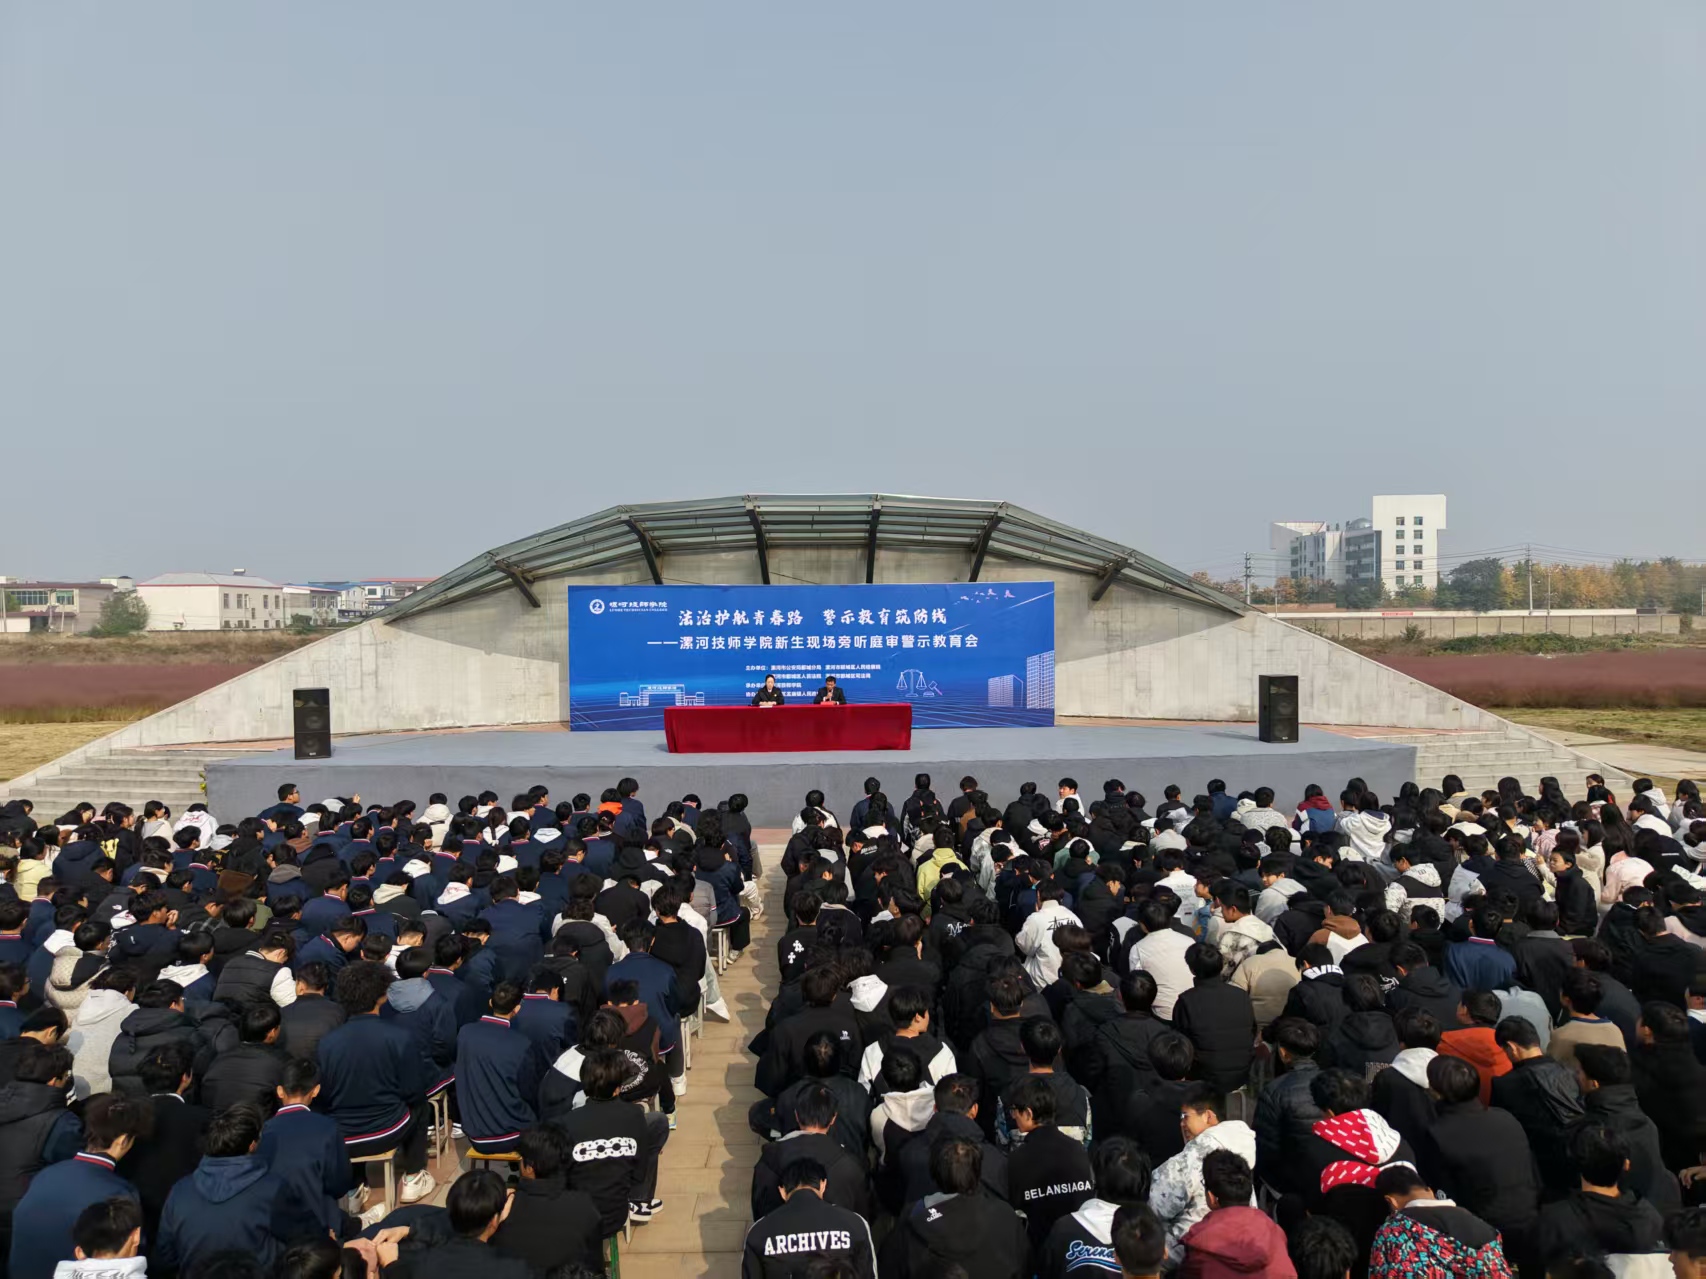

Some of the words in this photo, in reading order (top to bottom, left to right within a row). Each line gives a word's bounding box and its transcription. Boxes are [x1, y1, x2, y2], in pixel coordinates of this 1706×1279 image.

[678, 609, 803, 626] 法治护航青春路
[822, 608, 947, 626] 警示教育筑防线
[1024, 1180, 1092, 1201] BELANSIAGA
[764, 1231, 851, 1255] ARCHIVES
